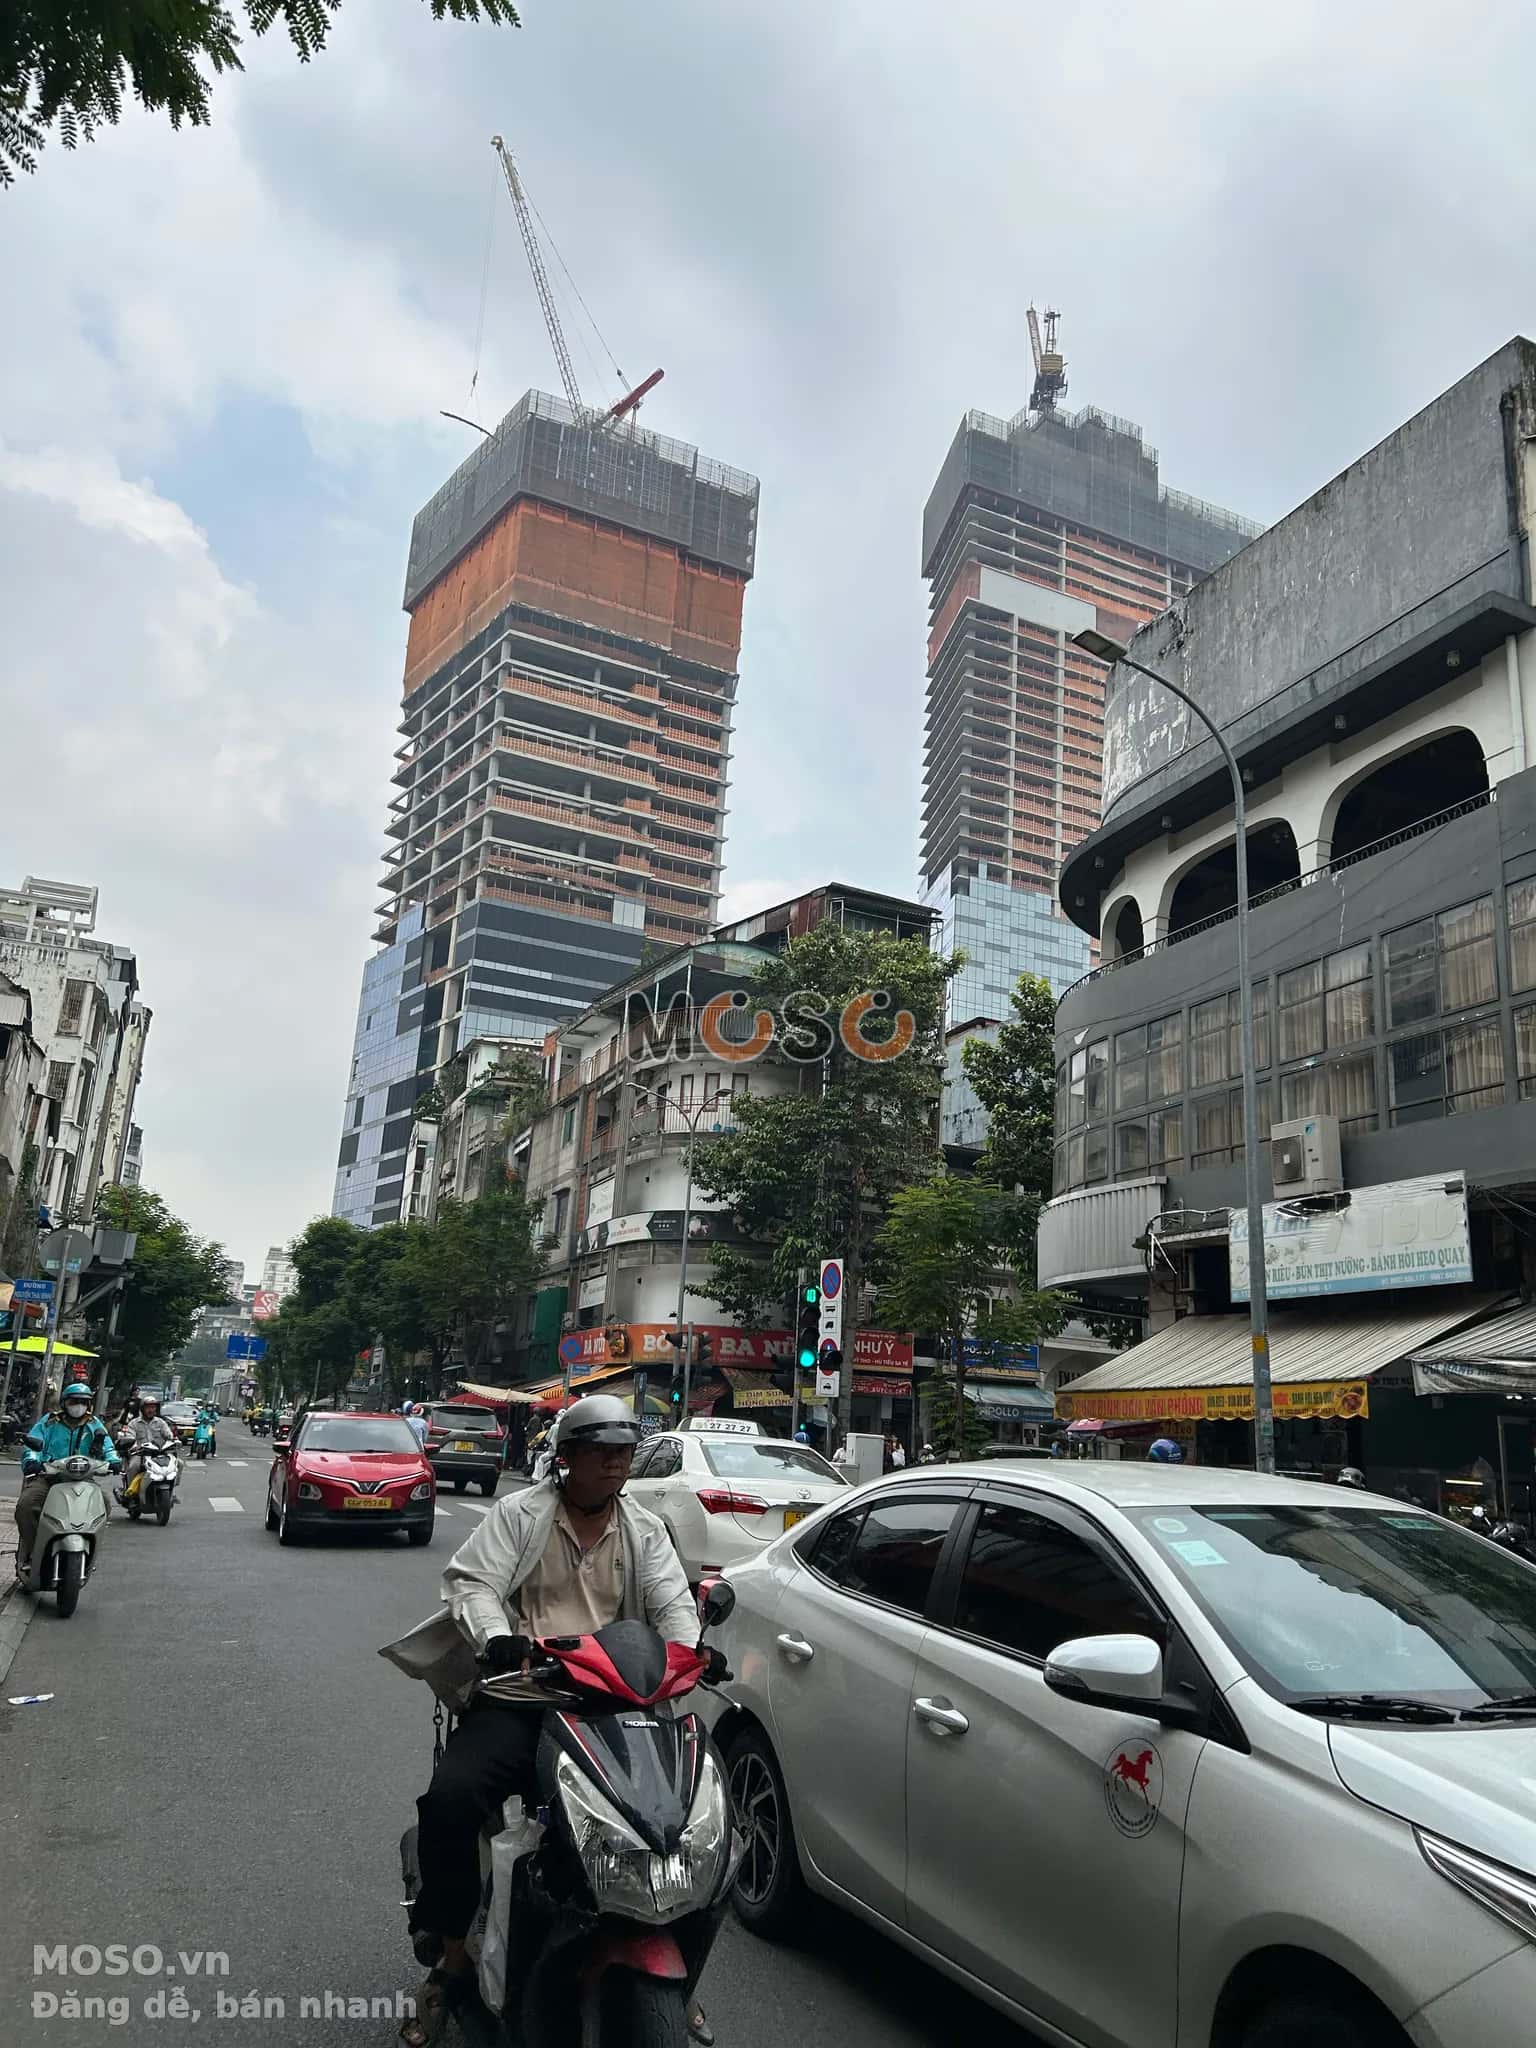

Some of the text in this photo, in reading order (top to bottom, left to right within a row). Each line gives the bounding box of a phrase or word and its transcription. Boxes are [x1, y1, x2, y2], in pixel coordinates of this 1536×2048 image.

[1417, 1252, 1436, 1268] HEO
[1437, 1246, 1466, 1268] QUAY
[709, 1422, 751, 1433] 27 27 27
